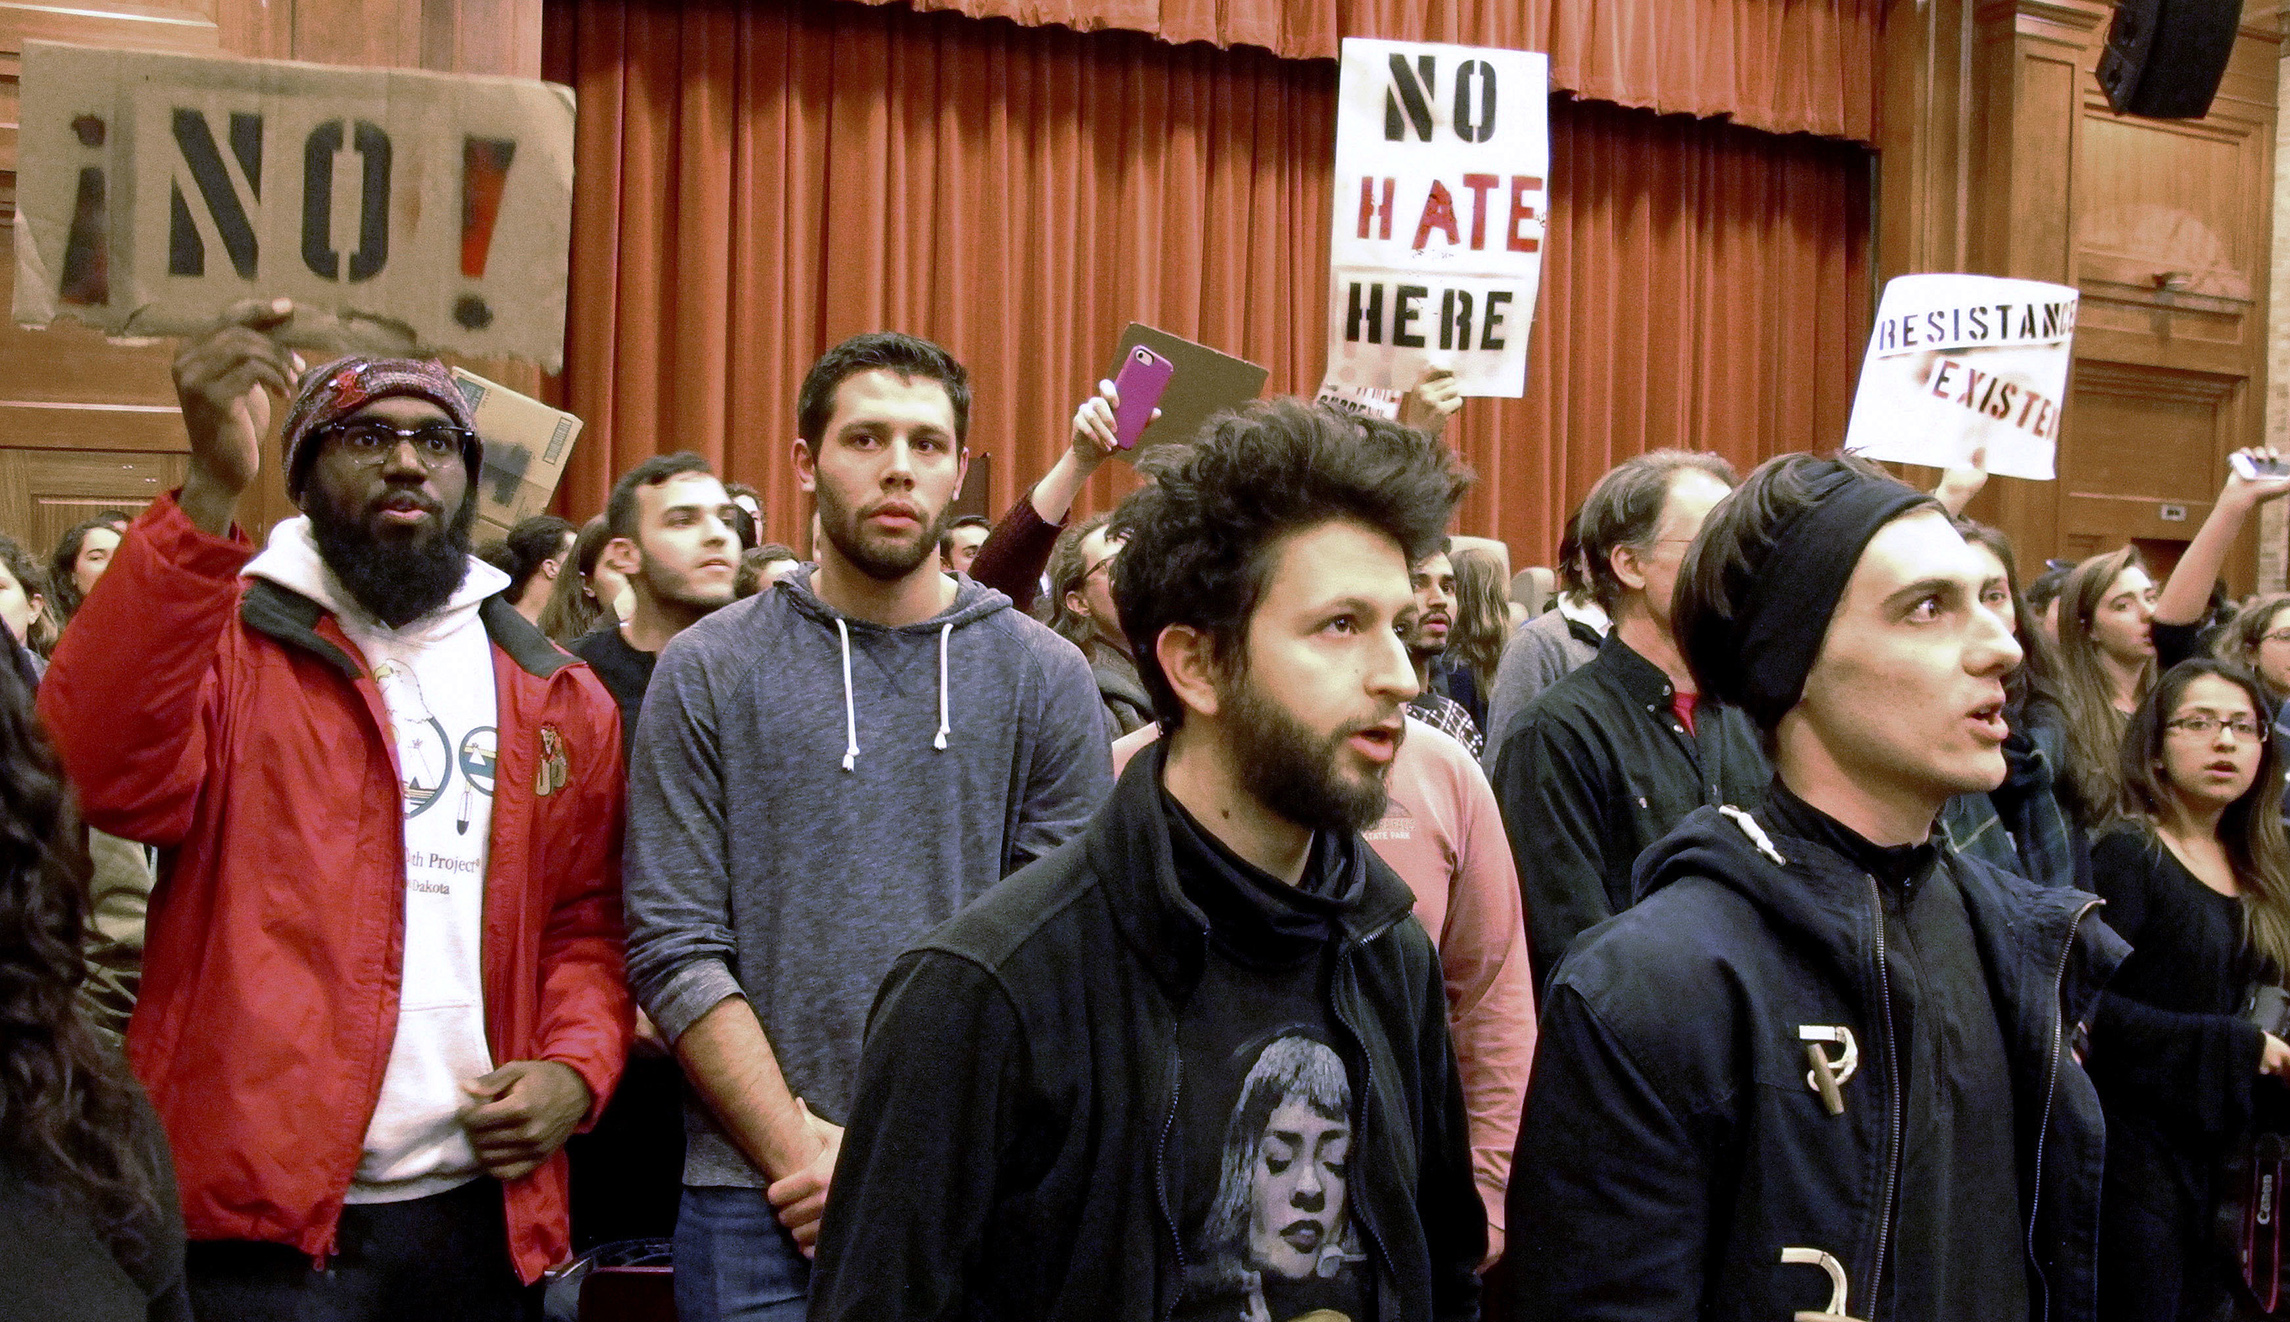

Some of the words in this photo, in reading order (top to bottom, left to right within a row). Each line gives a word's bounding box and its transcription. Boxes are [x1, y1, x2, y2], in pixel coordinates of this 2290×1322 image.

[1384, 53, 1497, 144] NO
[1356, 172, 1545, 254] HATE
[1345, 281, 1514, 352] HERE
[1879, 299, 2079, 351] RESISTANCE
[1362, 832, 1387, 841] STATE
[1391, 831, 1410, 840] PARK
[413, 880, 450, 894] Dakota
[2257, 1174, 2272, 1225] Canon
